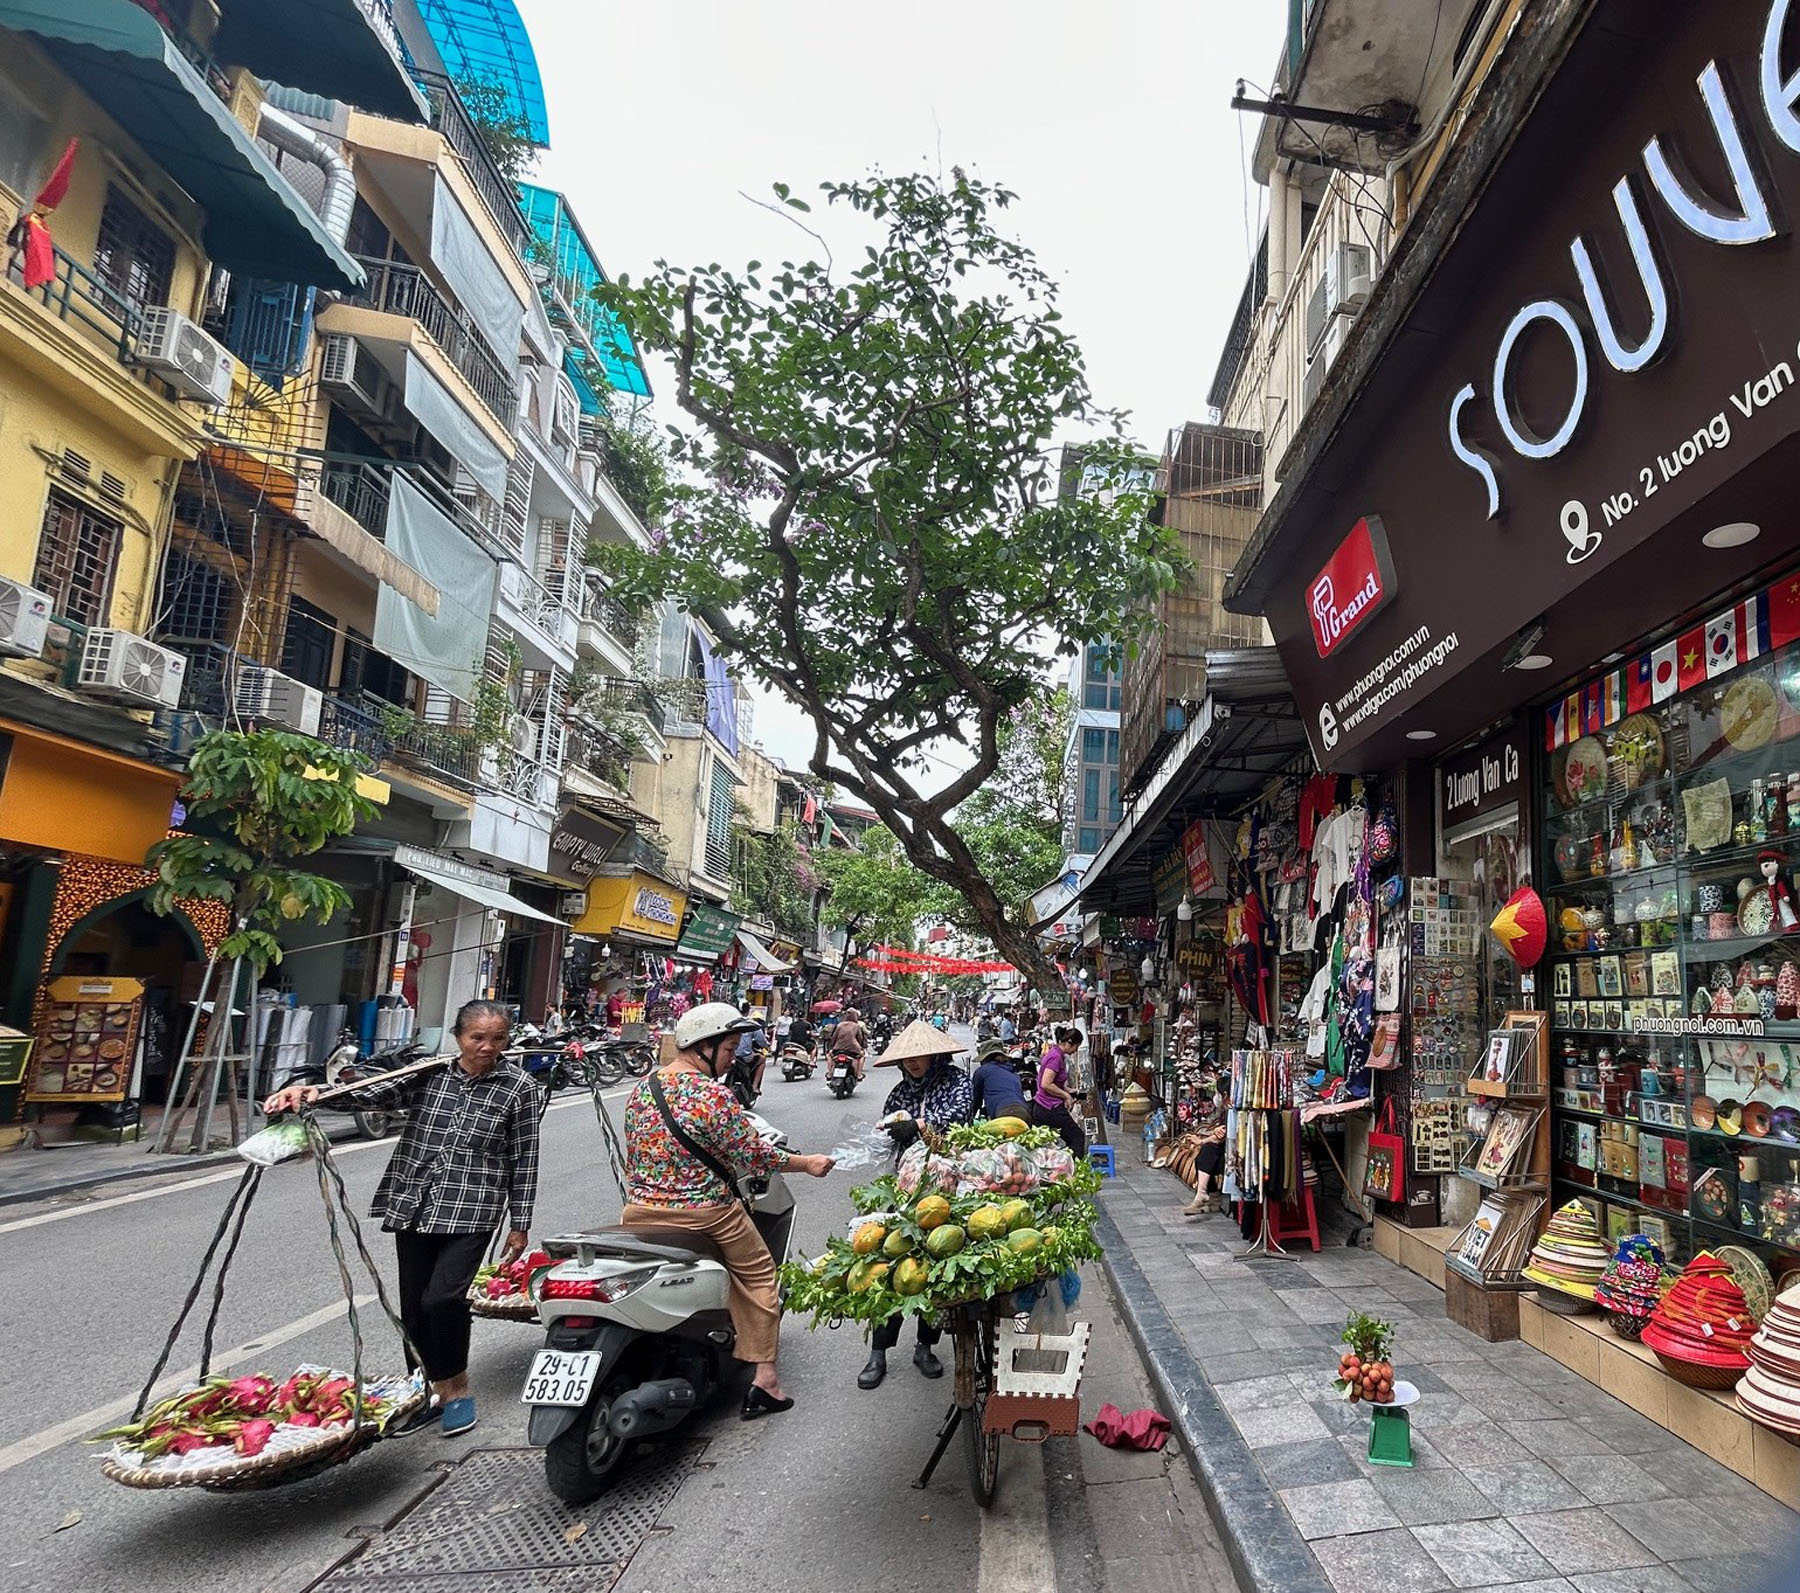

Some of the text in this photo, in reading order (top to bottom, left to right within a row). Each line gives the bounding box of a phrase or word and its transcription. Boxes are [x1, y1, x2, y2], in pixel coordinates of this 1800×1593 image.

[1601, 362, 1795, 527] No. 2 luong Van
[1505, 744, 1519, 783] Ca
[553, 831, 608, 865] EMPTY WALL
[1179, 950, 1213, 968] PHIN
[1633, 1014, 1764, 1037] phuongnoi.com.vn
[660, 1277, 695, 1288] LEAD
[538, 1354, 590, 1377] 29-C1
[525, 1378, 588, 1402] 583.05
